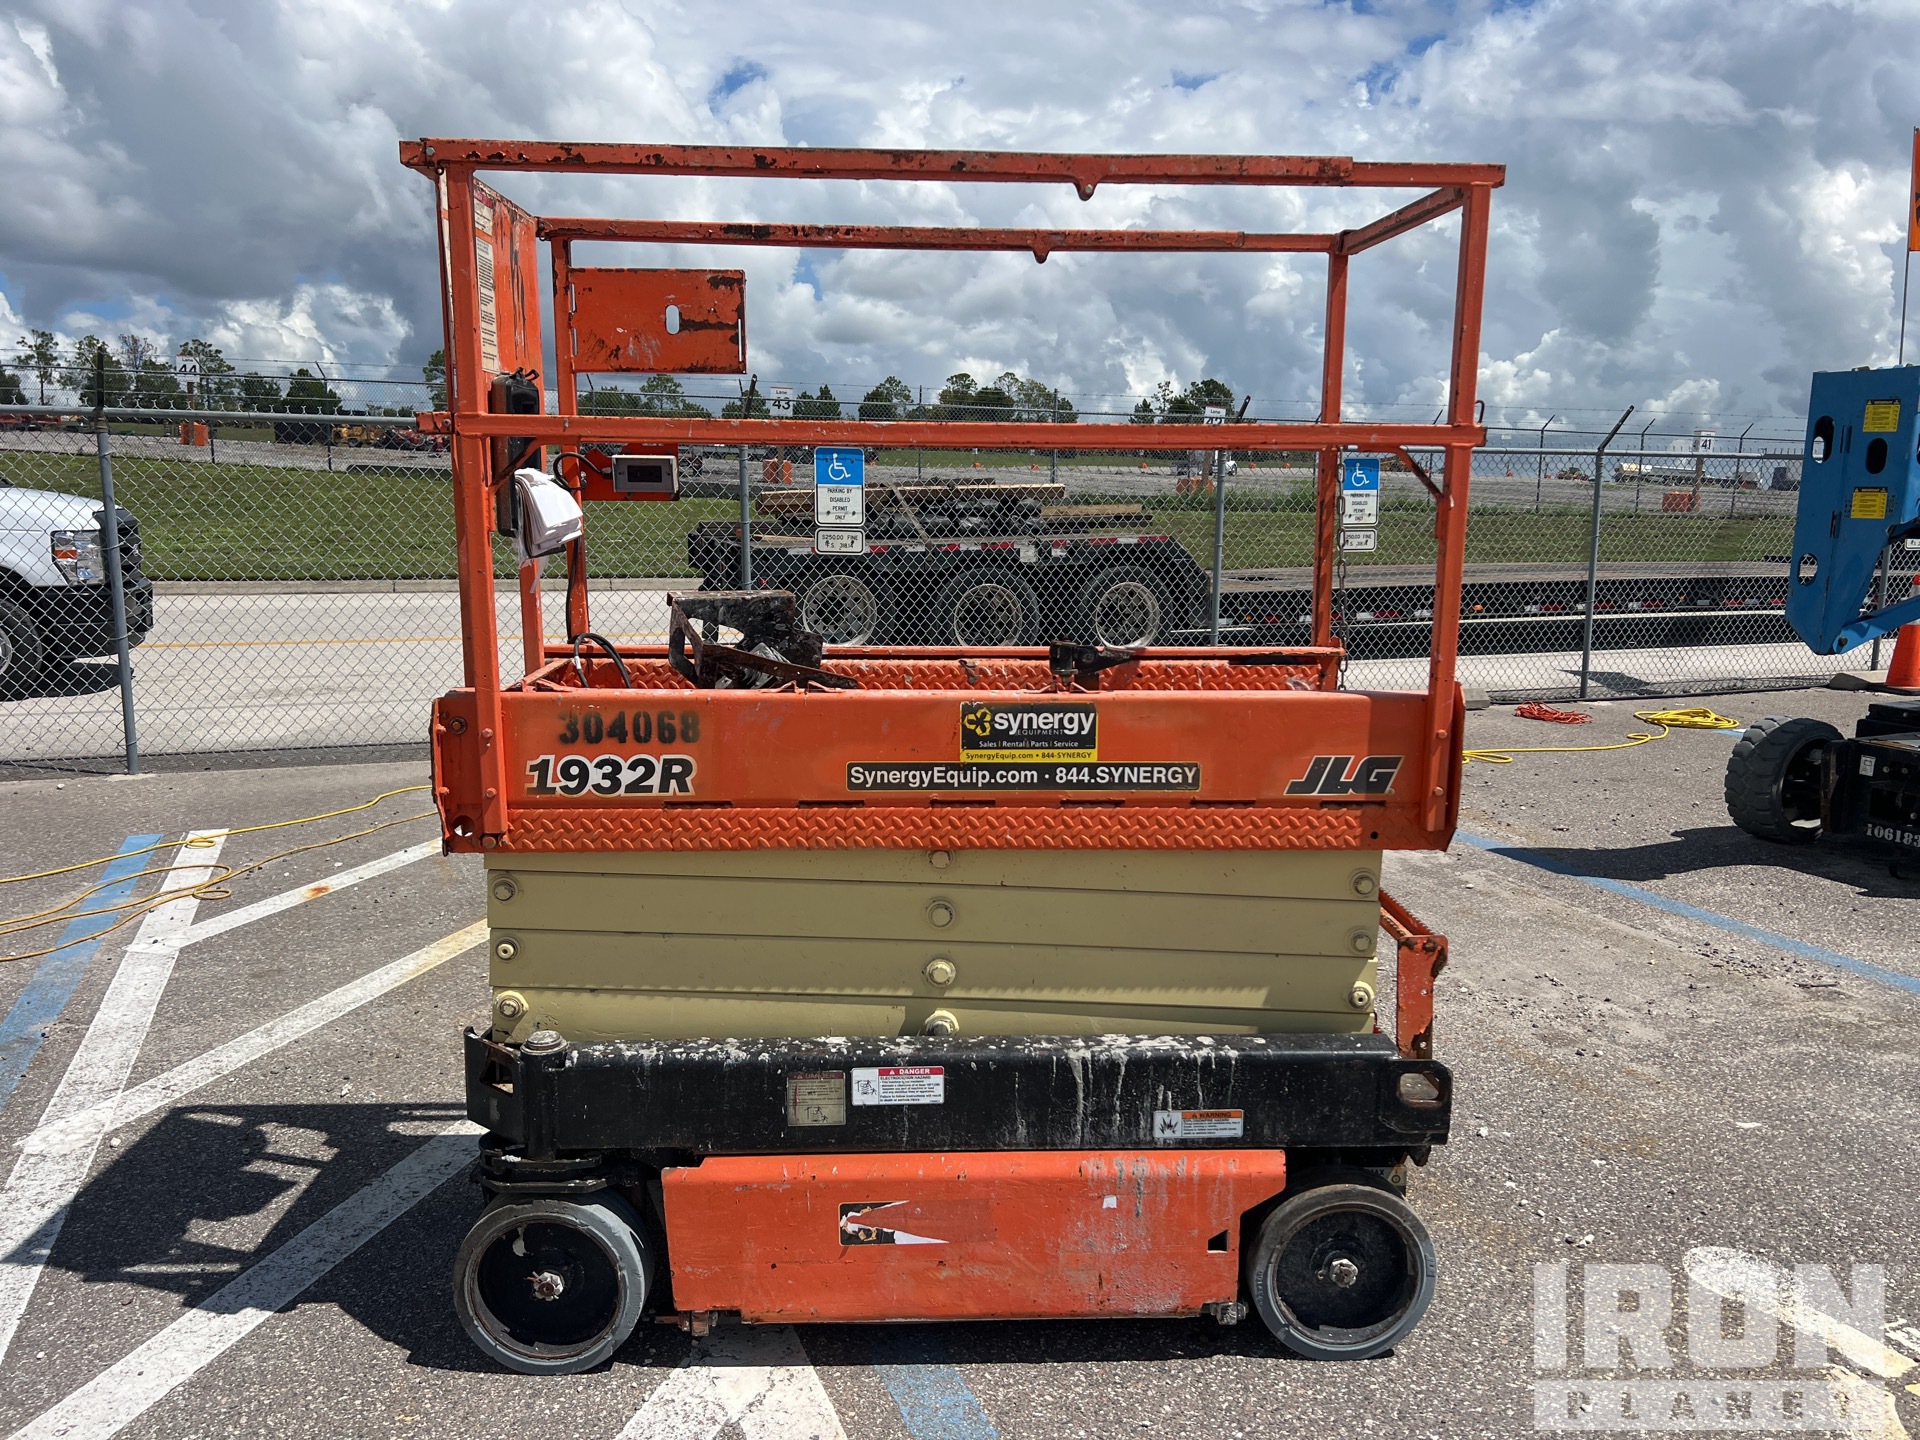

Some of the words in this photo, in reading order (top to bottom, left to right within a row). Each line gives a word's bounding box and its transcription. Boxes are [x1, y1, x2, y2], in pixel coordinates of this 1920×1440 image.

[772, 397, 790, 410] 43
[1701, 439, 1711, 450] 41
[559, 710, 701, 744] 304068
[993, 712, 1095, 735] synergy
[978, 740, 997, 748] Sales
[1002, 740, 1026, 748] Rental
[1030, 740, 1049, 748] Parts
[965, 752, 1034, 760] SynergyEquip.com
[525, 755, 696, 796] 1932R
[850, 766, 1038, 788] SynergyEquip.com
[1055, 766, 1197, 784] 844.SYNERGY
[1283, 755, 1404, 795] JLG
